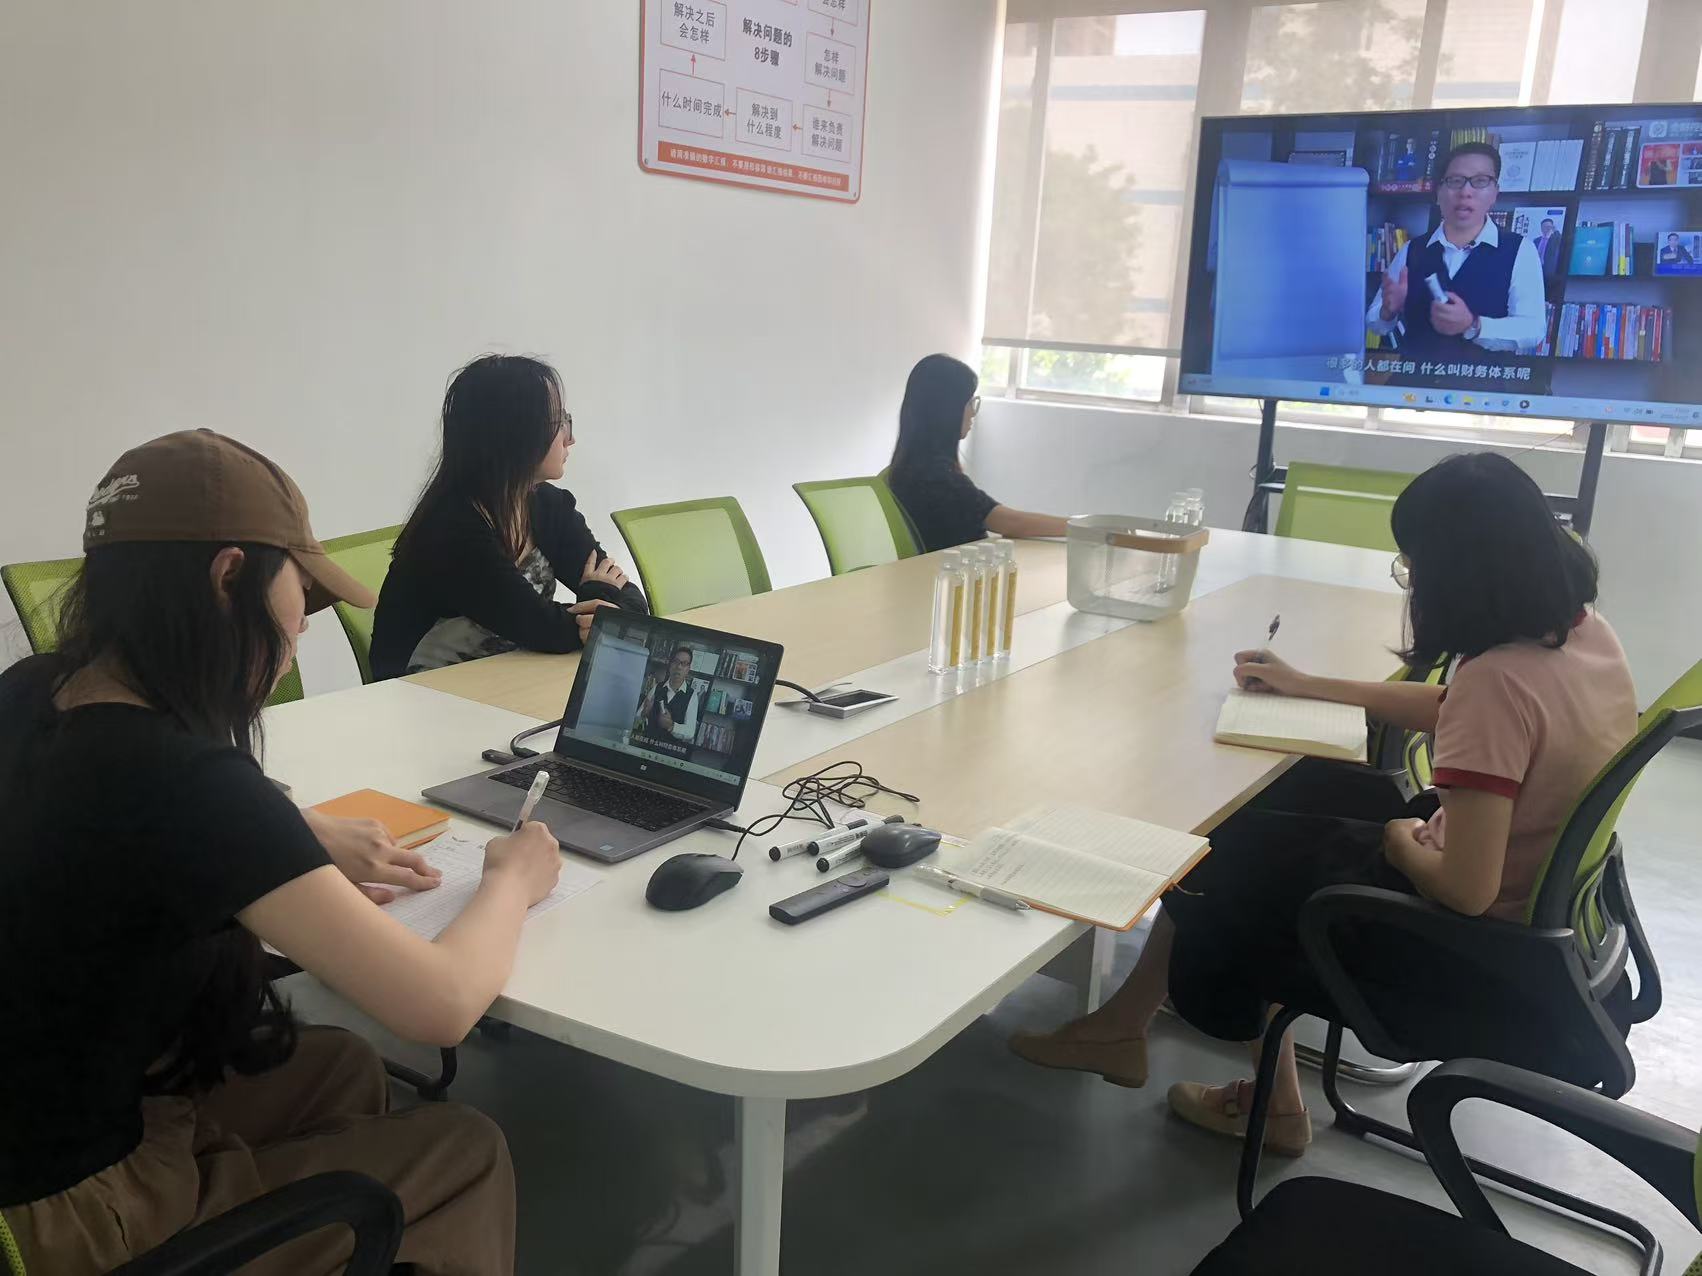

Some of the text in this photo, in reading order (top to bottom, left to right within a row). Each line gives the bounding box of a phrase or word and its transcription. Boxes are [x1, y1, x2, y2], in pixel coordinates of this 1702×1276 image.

[674, 1, 715, 28] 解决之后
[679, 23, 710, 44] 会怎样
[742, 17, 793, 47] 解决问题的
[754, 46, 780, 67] 8步骤
[823, 48, 840, 64] 怎样
[814, 62, 847, 83] 解决问题
[661, 90, 722, 118] 什么时间完成
[751, 103, 778, 121] 解决到
[746, 118, 782, 140] 什么程度
[811, 133, 843, 153] 解决问题
[1420, 362, 1531, 381] 什么叫财务体系呢
